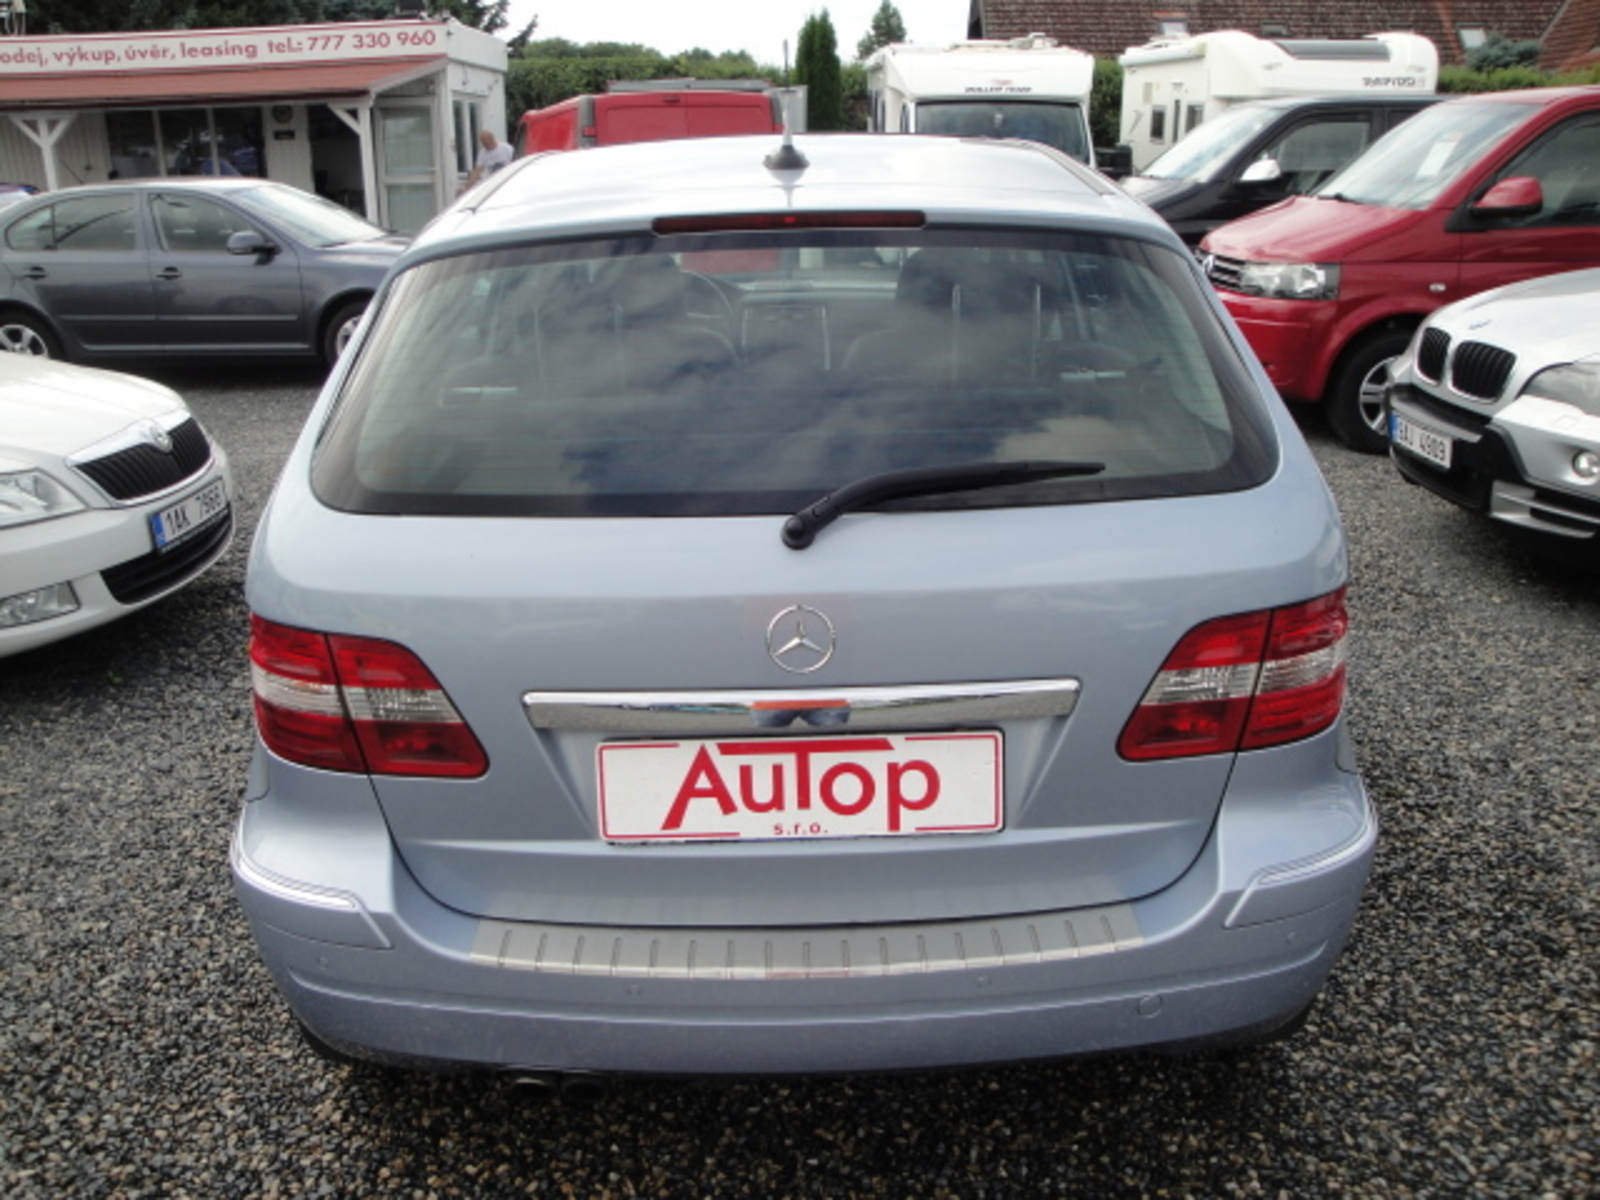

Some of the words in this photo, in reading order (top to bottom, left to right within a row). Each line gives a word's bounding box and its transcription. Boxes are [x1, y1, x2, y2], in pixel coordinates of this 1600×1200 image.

[52, 45, 121, 67] výkup,
[180, 41, 258, 59] leasing
[306, 34, 345, 51] 777
[352, 32, 391, 49] 330
[397, 29, 436, 46] 960
[165, 504, 191, 535] 1AK
[773, 822, 828, 836] s.r.o.
